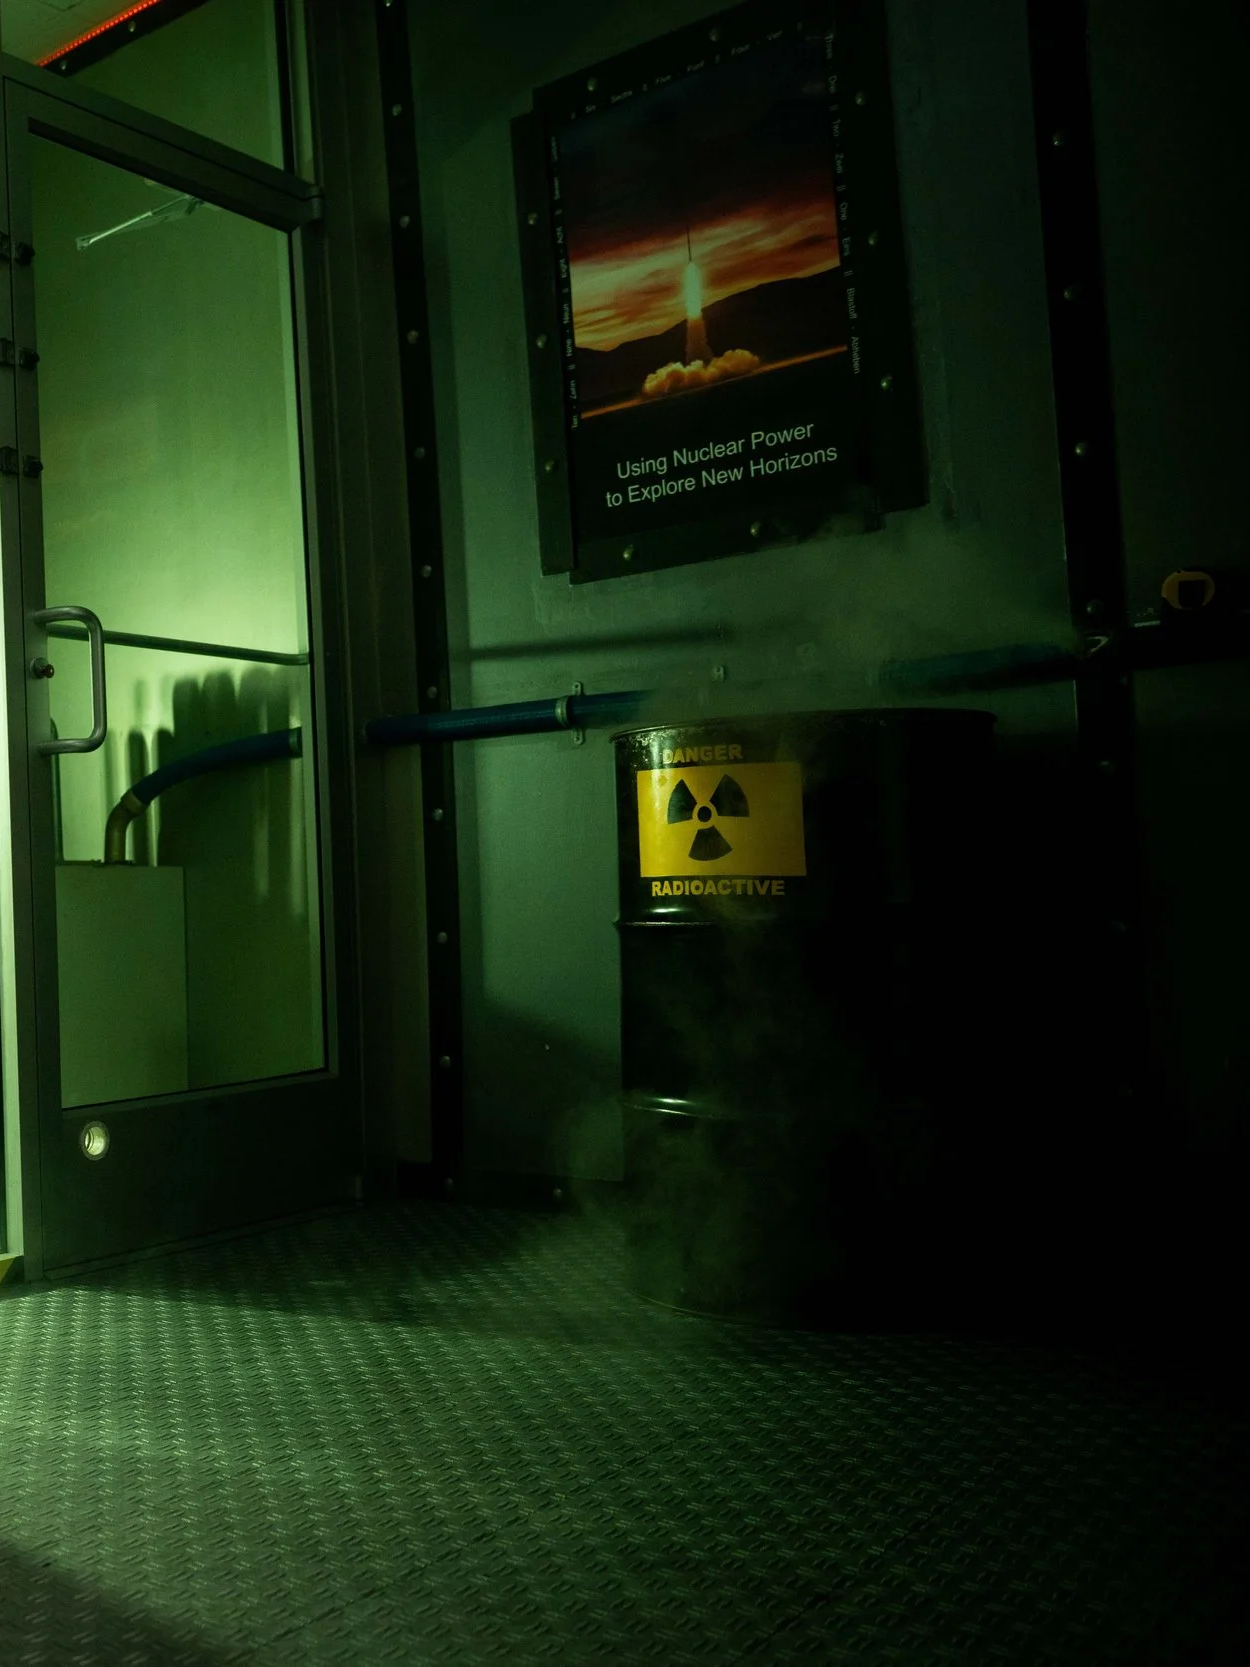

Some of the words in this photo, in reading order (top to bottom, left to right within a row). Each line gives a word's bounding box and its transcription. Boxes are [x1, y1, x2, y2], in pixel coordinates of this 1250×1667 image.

[616, 456, 668, 479] Using
[673, 437, 746, 467] Nuclear
[751, 423, 815, 450] Power
[606, 491, 623, 507] to
[628, 477, 696, 502] Explore
[701, 465, 744, 487] New
[750, 446, 838, 477] Horizons
[662, 743, 744, 764] DANGER
[651, 879, 786, 897] RADIOACTIVE
